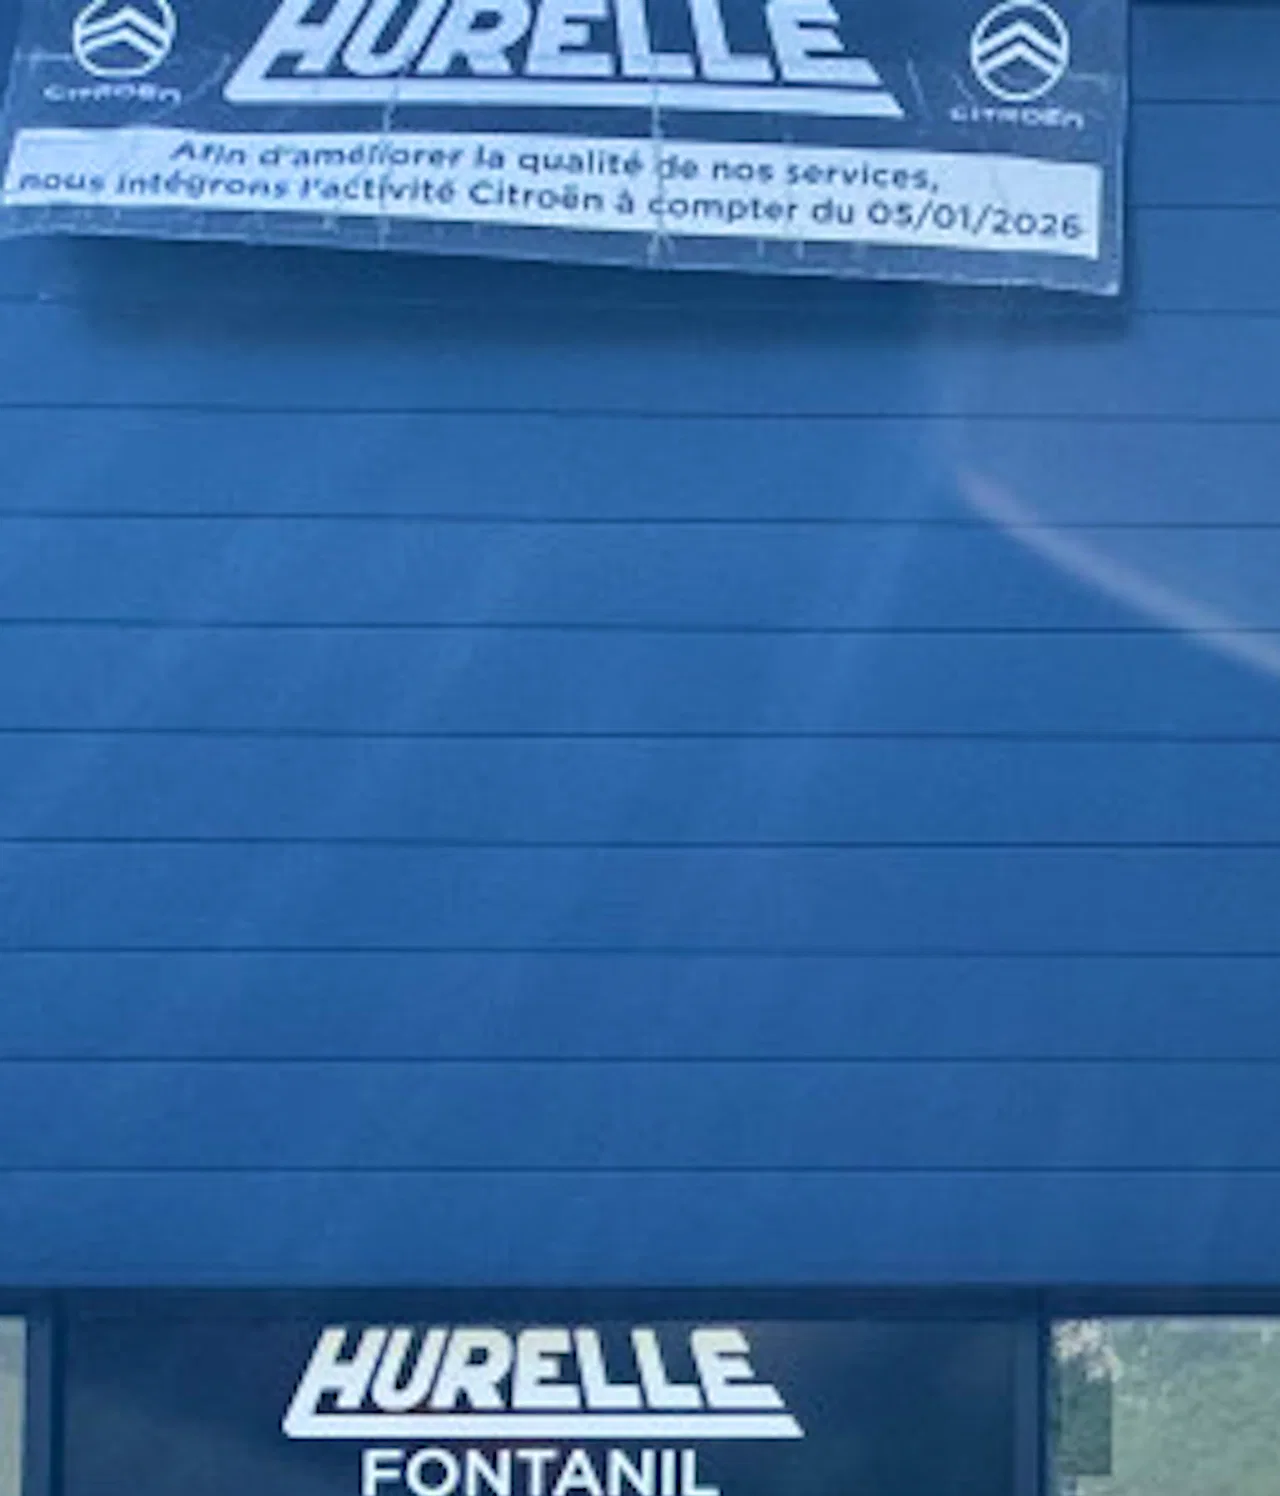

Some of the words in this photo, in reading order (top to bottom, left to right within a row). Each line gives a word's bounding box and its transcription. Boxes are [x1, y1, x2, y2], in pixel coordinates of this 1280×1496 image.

[168, 139, 245, 167] Afin
[259, 143, 465, 169] d'améliorer
[475, 145, 505, 170] la
[518, 149, 645, 177] qualité
[656, 154, 699, 181] de
[712, 162, 774, 183] nos
[787, 161, 940, 194] services,
[19, 174, 105, 193] nous
[116, 170, 288, 200] intégrons
[303, 175, 457, 204] l'activité
[469, 180, 604, 212] Citroën
[614, 190, 635, 216] à
[649, 197, 799, 224] compter
[812, 199, 855, 227] du
[867, 201, 1085, 240] 05/01/2026
[284, 1327, 797, 1435] HURELLE
